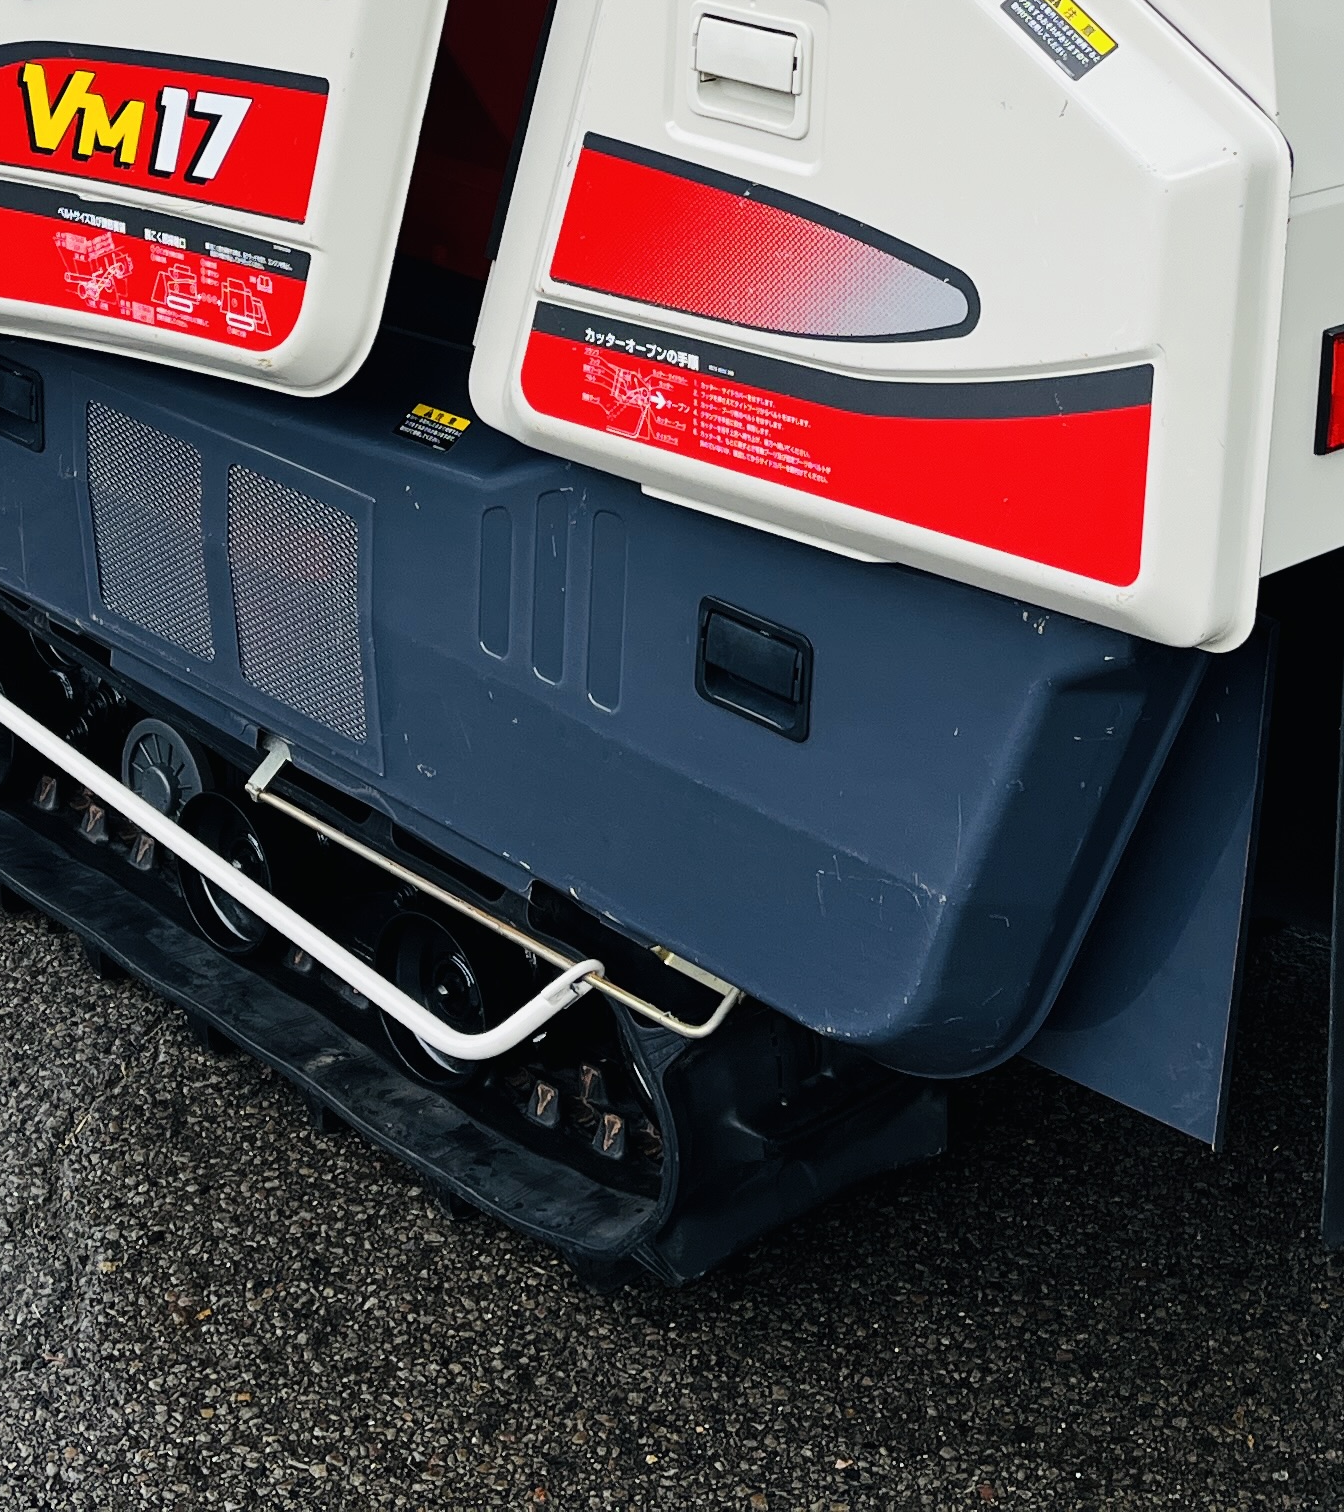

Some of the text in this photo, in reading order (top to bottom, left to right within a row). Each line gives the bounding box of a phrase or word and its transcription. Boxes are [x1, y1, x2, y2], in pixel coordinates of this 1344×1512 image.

[18, 62, 253, 185] VM17
[584, 327, 700, 372] カッターオープンの手順
